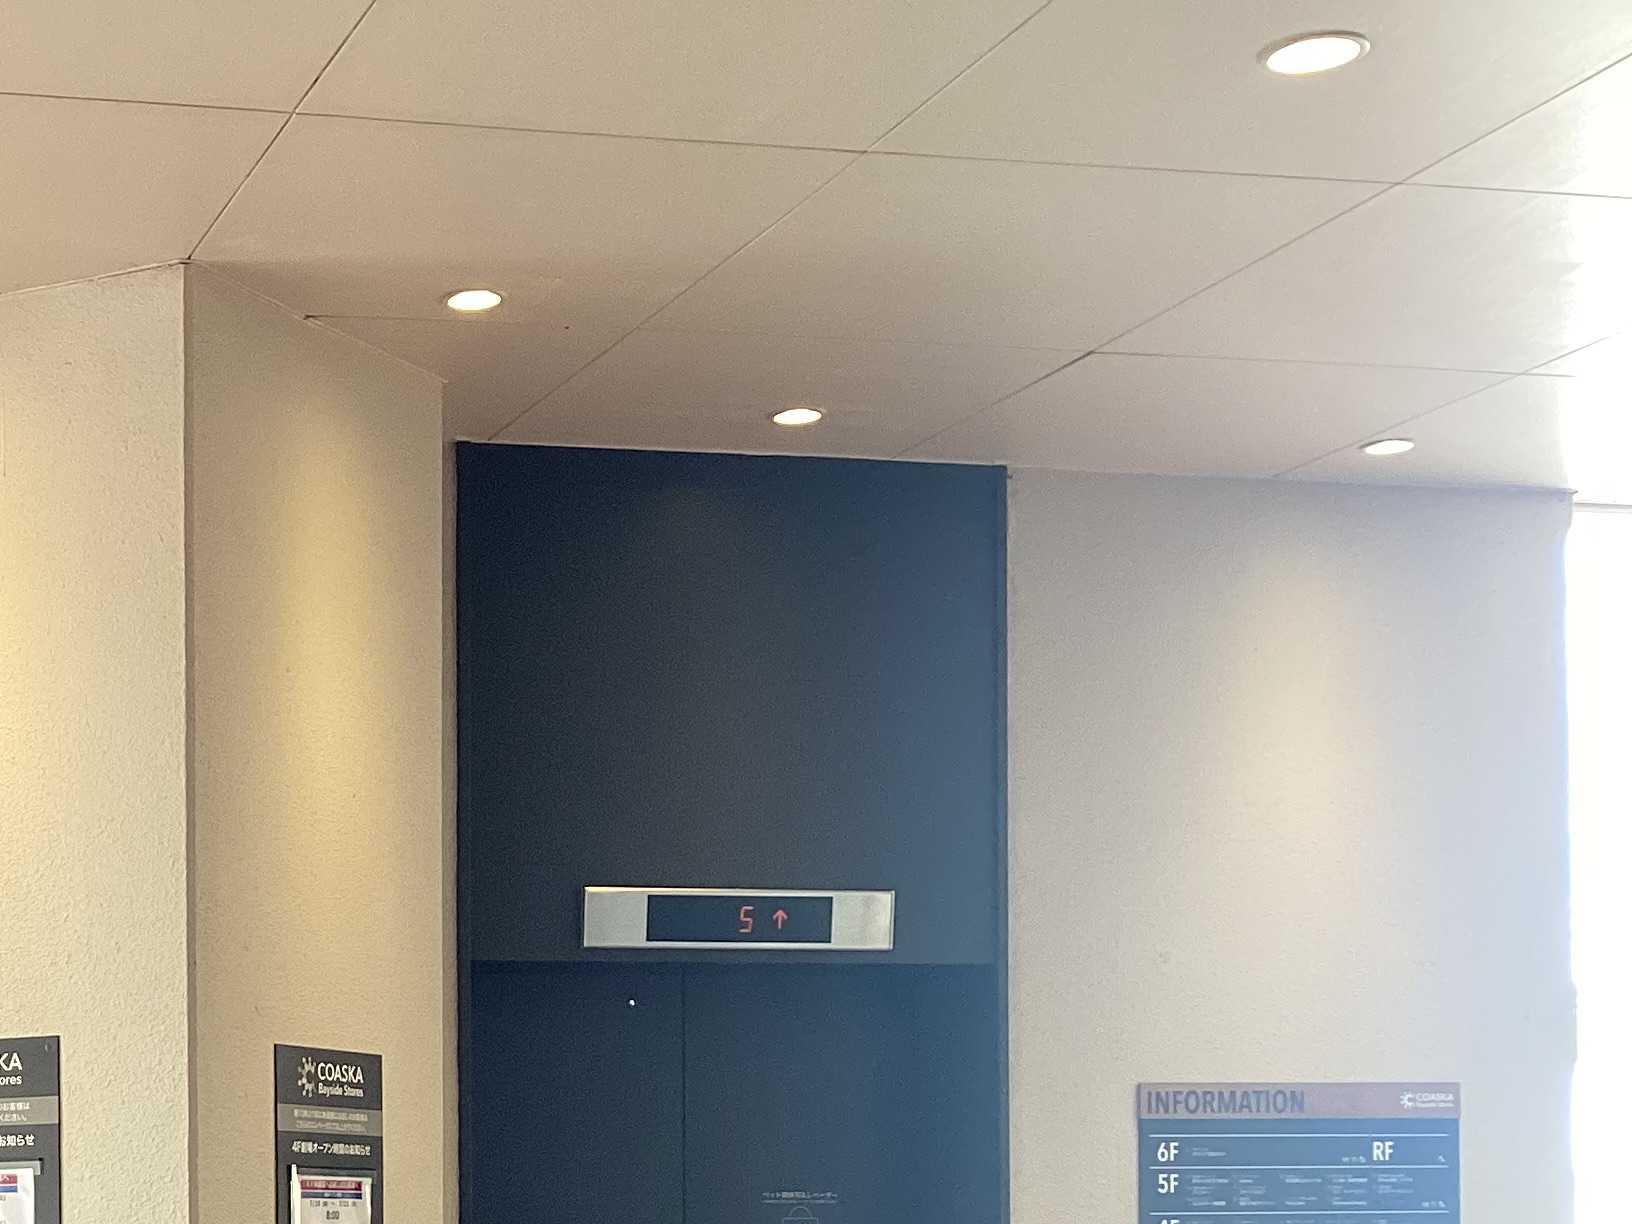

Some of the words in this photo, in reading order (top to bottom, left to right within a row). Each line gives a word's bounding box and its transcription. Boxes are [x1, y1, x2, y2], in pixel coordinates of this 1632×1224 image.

[739, 906, 754, 932] 5
[318, 1062, 364, 1084] COASKA
[319, 1083, 343, 1098] Bayside
[1148, 1090, 1305, 1113] INFORMATION
[1157, 1142, 1179, 1162] 6F
[1372, 1141, 1394, 1160] RF
[1157, 1173, 1179, 1193] 5F
